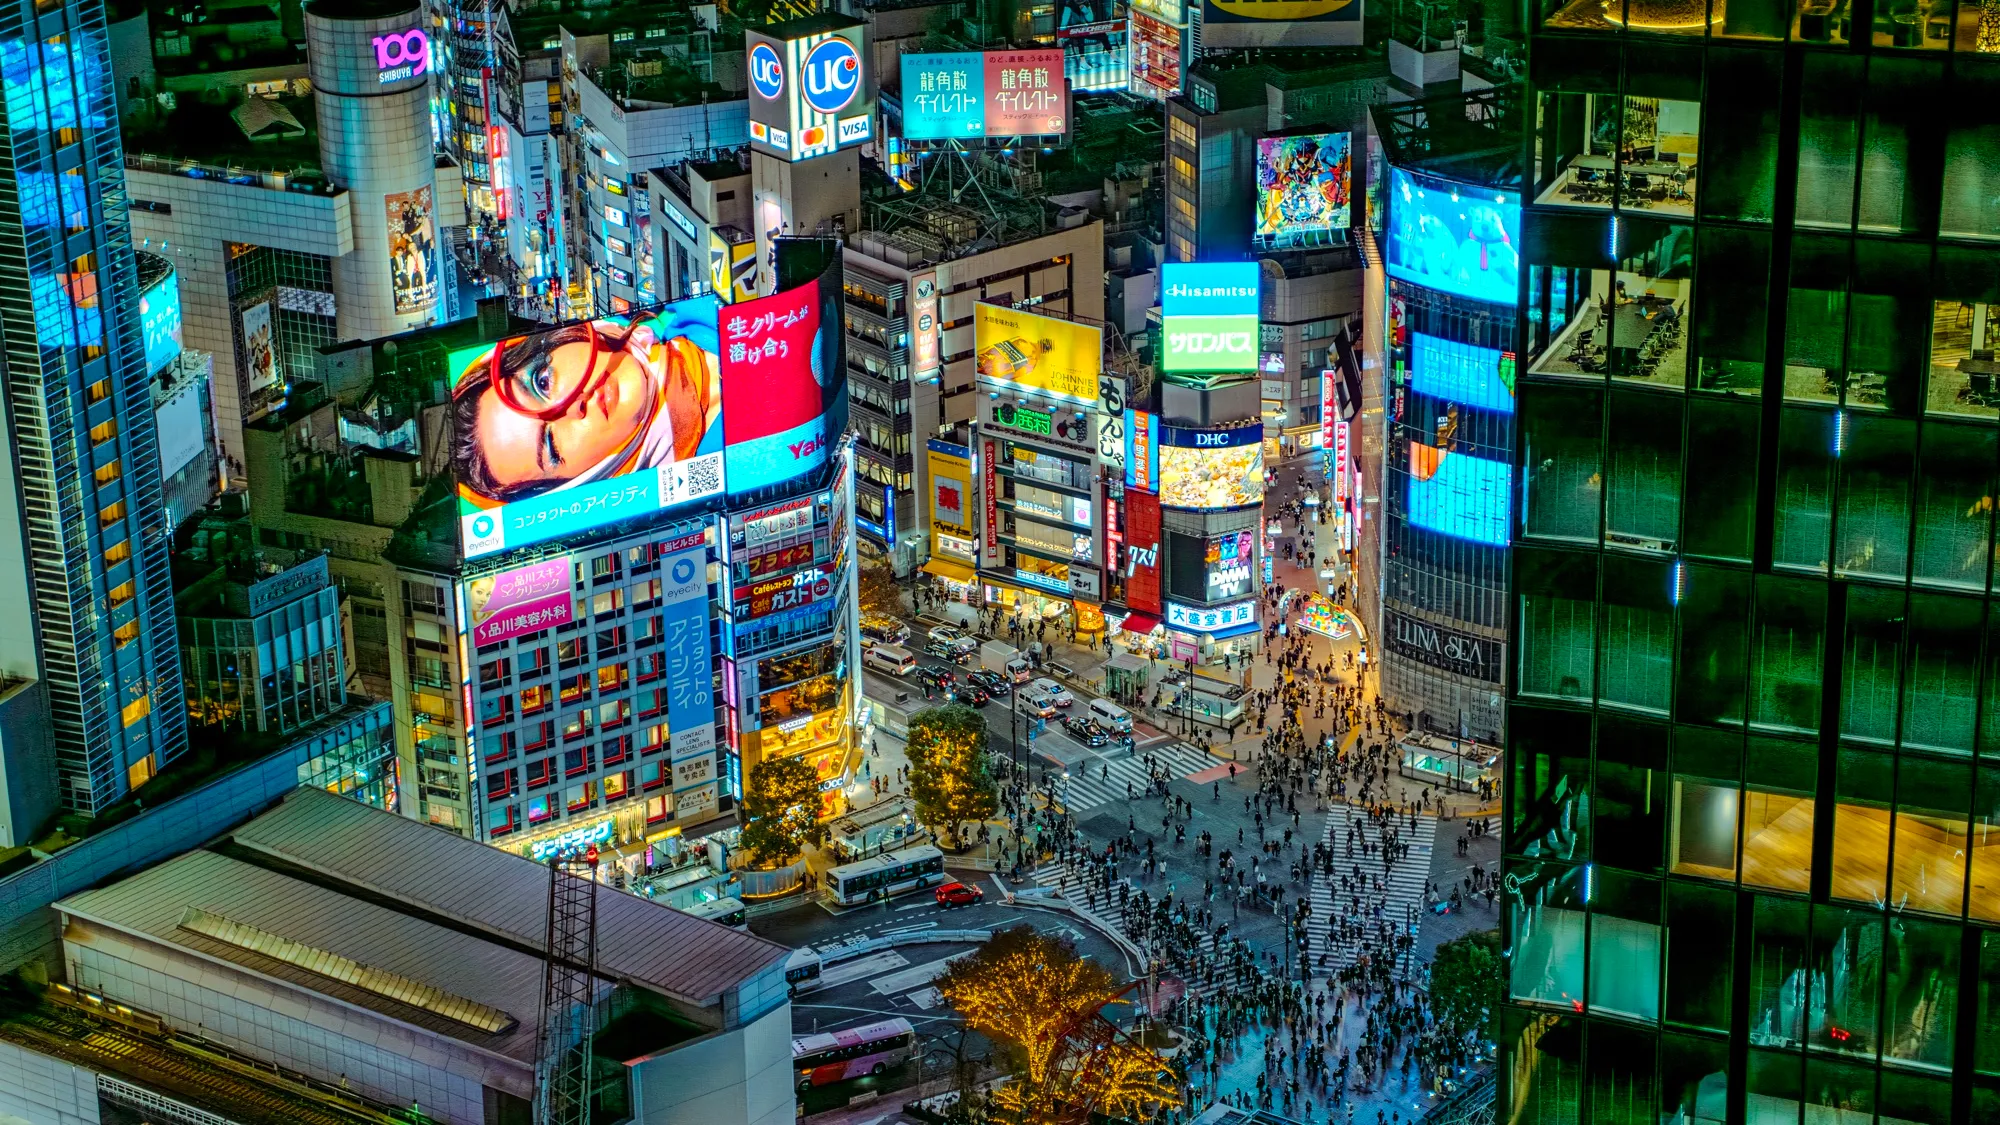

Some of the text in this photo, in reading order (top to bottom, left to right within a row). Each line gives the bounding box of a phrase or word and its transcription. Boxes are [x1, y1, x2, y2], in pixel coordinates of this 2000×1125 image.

[1069, 23, 1114, 35] SKECHERS
[372, 29, 428, 76] 109
[379, 66, 412, 83] SHIBUYA
[752, 56, 780, 87] UC
[808, 55, 856, 95] UC
[920, 70, 968, 92] 龍角散
[1001, 67, 1049, 90] 龍角散
[913, 93, 977, 114] ダイレクト
[995, 90, 1058, 112] ダイレクト
[772, 132, 788, 144] VISA
[842, 120, 868, 136] VISA
[1165, 283, 1257, 297] Hisamitsu
[727, 305, 809, 340] 生クリームが
[729, 337, 789, 365] 溶け合う
[1169, 332, 1253, 354] サロンパス
[1051, 371, 1094, 387] JOHNNIE
[1051, 380, 1094, 396] WALKER
[1018, 414, 1051, 435] 西村
[1323, 404, 1333, 444] カラオケ
[1196, 432, 1229, 446] DHC
[1337, 426, 1347, 468] カラオケ
[1134, 416, 1147, 486] 三千里薬品
[513, 485, 649, 530] コンタクトのアイシティ
[769, 511, 808, 533] しゃぶ葉
[468, 537, 500, 552] eyecity
[664, 535, 701, 552] 当ビル5F
[731, 530, 745, 542] 9F
[1128, 542, 1159, 577] クスリ
[514, 565, 565, 587] 品川スキン
[793, 568, 825, 586] ガスト
[1209, 565, 1250, 587] DMM
[514, 578, 560, 599] クリニック
[667, 582, 702, 599] eyecity
[1219, 581, 1239, 598] TV
[735, 604, 750, 617] 7F
[771, 589, 809, 611] ガスト
[488, 603, 567, 638] 品川美容外科
[1173, 605, 1249, 627] 大盛堂書店
[1397, 618, 1485, 665] LUNA SEA
[669, 618, 693, 709] アイシティ
[690, 615, 708, 705] コンタクトの
[680, 729, 705, 741] CONTACT
[686, 736, 700, 746] LENS
[676, 739, 710, 755] SPECIALISTS
[531, 820, 614, 862] サンドラッグ
